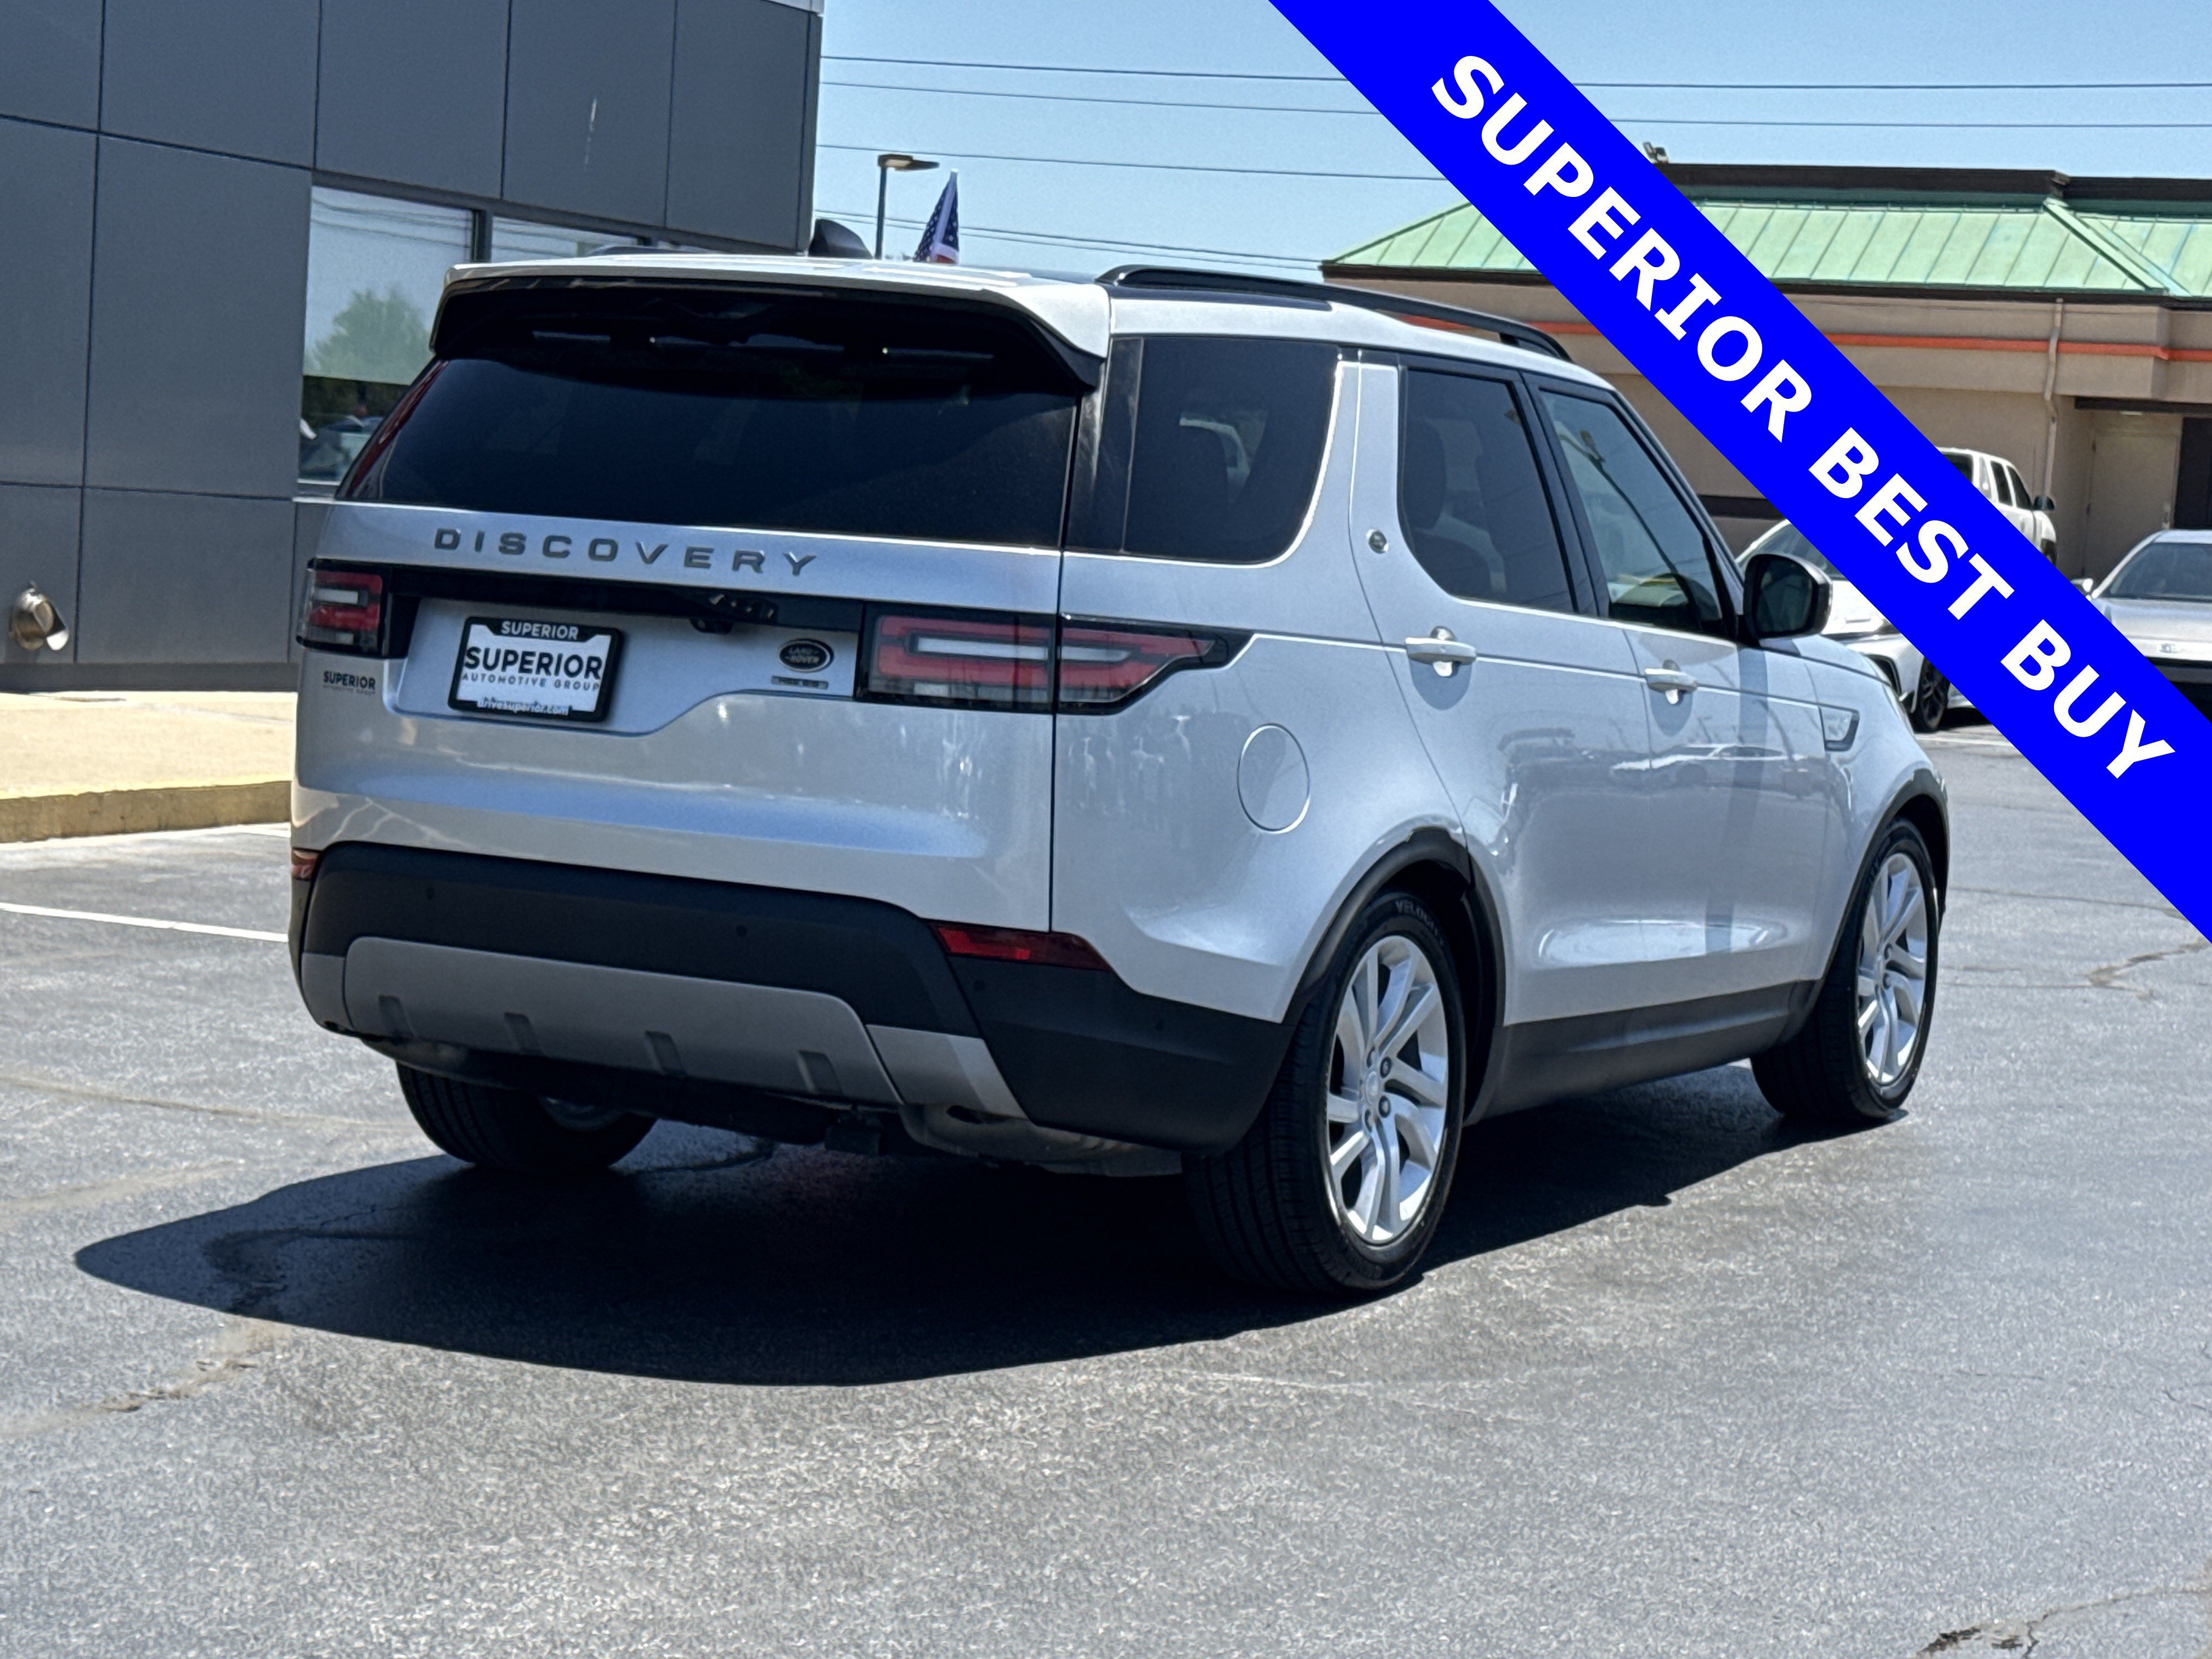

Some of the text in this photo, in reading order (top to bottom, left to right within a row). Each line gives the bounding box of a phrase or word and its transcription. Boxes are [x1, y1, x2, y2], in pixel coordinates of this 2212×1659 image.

[434, 528, 816, 576] DISCOVERY
[501, 621, 579, 640] SUPERIOR
[464, 646, 602, 680] SUPERIOR
[323, 670, 376, 690] SUPERIOR
[462, 673, 600, 692] AUTOMOTIVE GROUP
